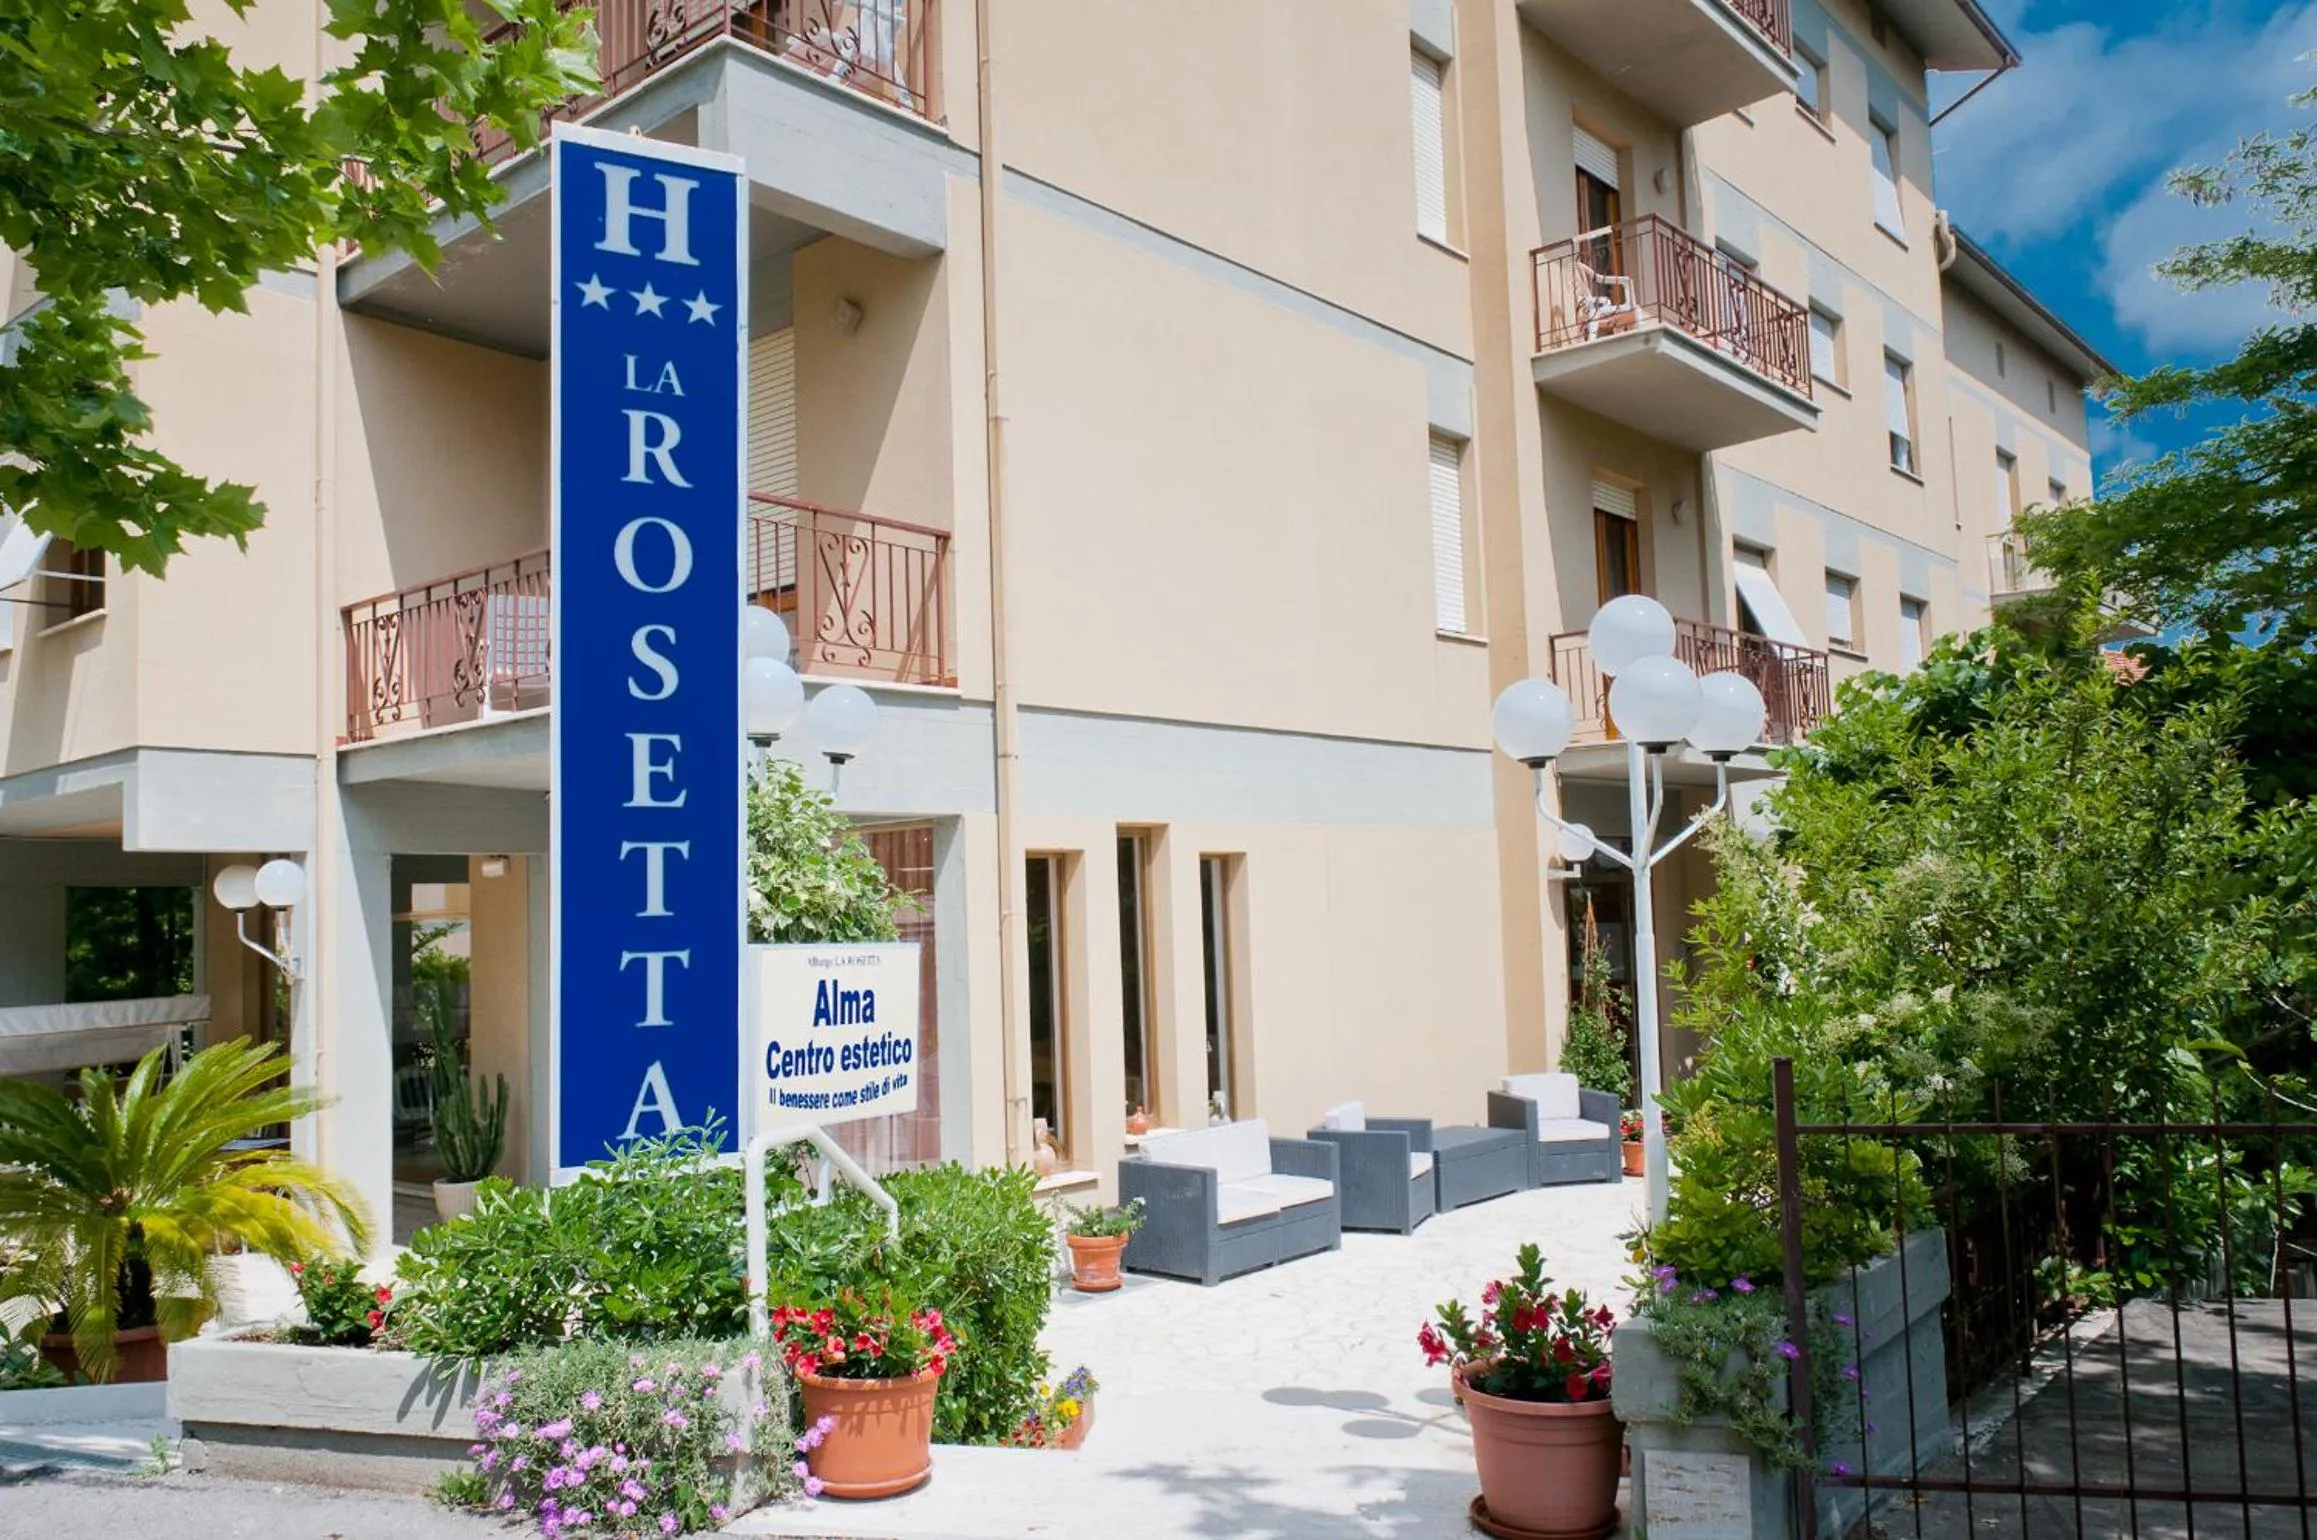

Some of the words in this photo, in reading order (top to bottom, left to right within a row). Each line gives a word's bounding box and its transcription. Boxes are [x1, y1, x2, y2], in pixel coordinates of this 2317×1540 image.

[594, 161, 701, 266] H
[623, 353, 686, 397] LA
[613, 408, 694, 1141] ROSETTA
[813, 979, 875, 1027] Alma
[766, 1040, 835, 1080] Centro
[840, 1031, 912, 1072] estetico
[769, 1087, 777, 1105] Il
[779, 1089, 830, 1110] benessere
[832, 1092, 858, 1109] come
[859, 1080, 880, 1104] stile
[881, 1075, 891, 1096] di
[892, 1073, 908, 1092] vita
